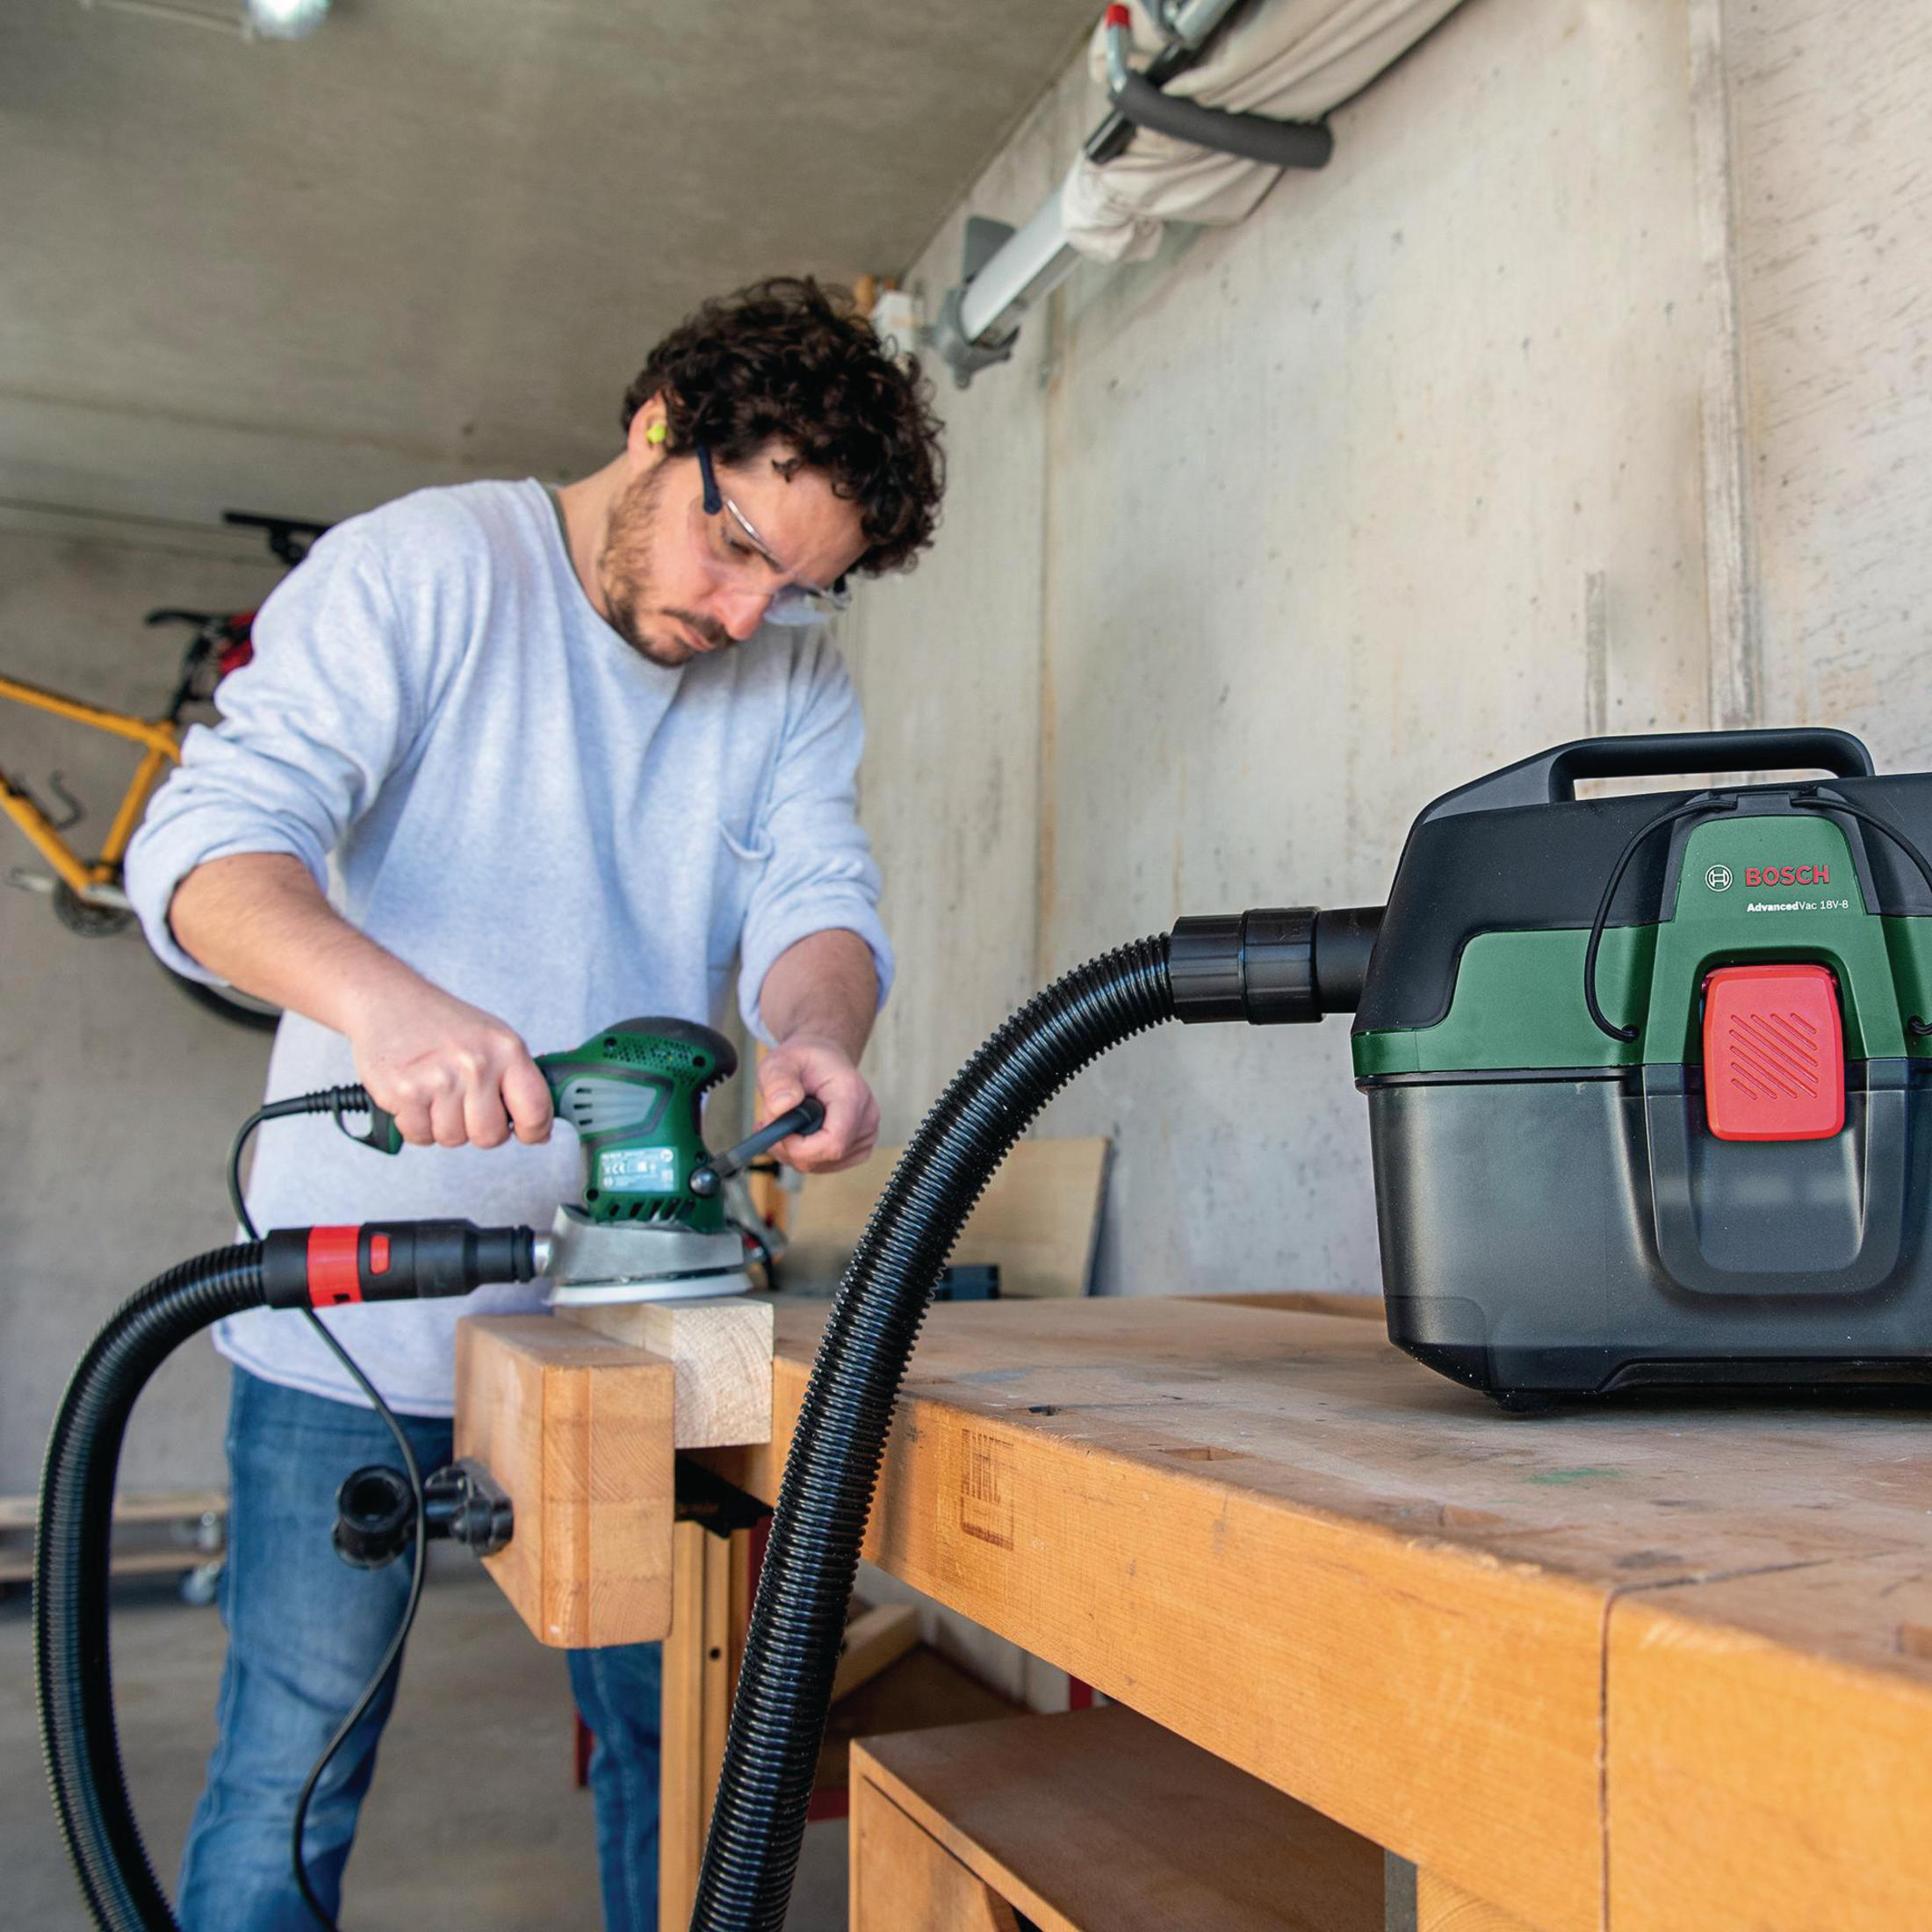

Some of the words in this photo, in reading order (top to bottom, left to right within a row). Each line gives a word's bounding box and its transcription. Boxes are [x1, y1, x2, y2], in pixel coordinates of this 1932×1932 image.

[1746, 865, 1829, 887] BOSCH
[1747, 901, 1817, 912] AdvancedVac
[1820, 900, 1849, 909] 18V-8
